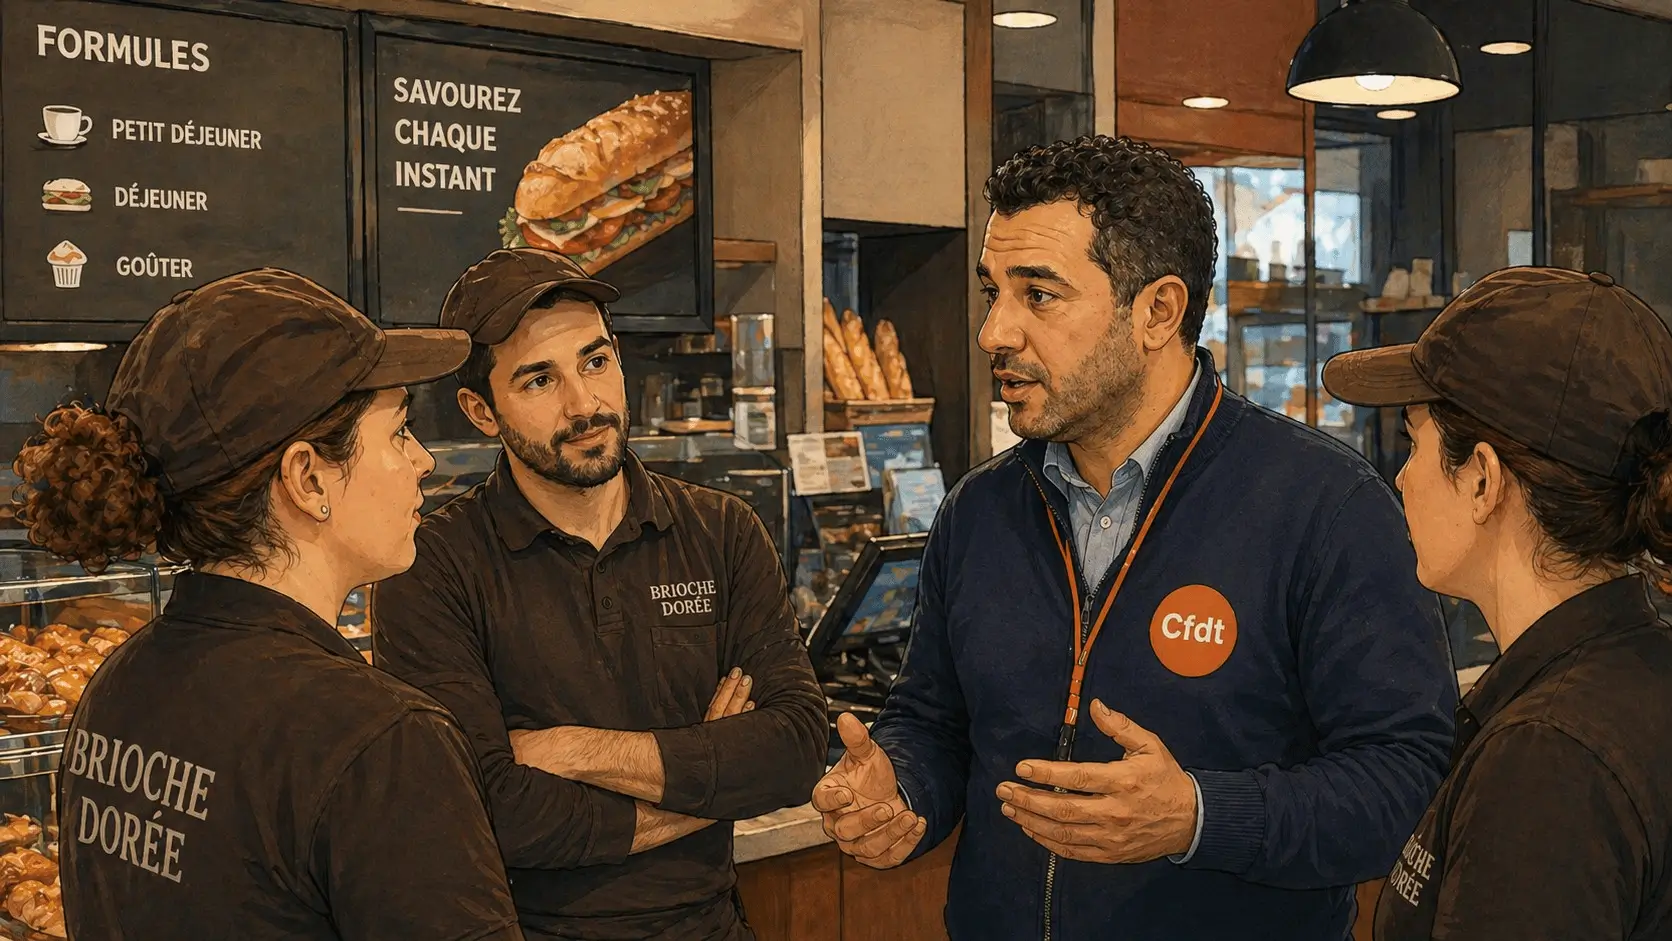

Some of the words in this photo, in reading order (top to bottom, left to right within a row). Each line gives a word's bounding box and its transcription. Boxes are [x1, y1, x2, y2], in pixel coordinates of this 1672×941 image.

[37, 24, 210, 73] FORMULES
[393, 76, 522, 114] SAVOUREZ
[112, 118, 166, 143] PETIT
[171, 119, 262, 150] DÉJEUNER
[394, 118, 497, 153] CHAQUE
[395, 160, 497, 192] INSTANT
[114, 182, 208, 211] DÉJEUNER
[116, 252, 194, 279] GOÛTER
[649, 580, 717, 600] BRIOCHE
[660, 596, 712, 617] DORÉE
[1161, 612, 1225, 645] Cfdt
[69, 728, 216, 821] BRIOCHE
[77, 796, 186, 883] DORÉE
